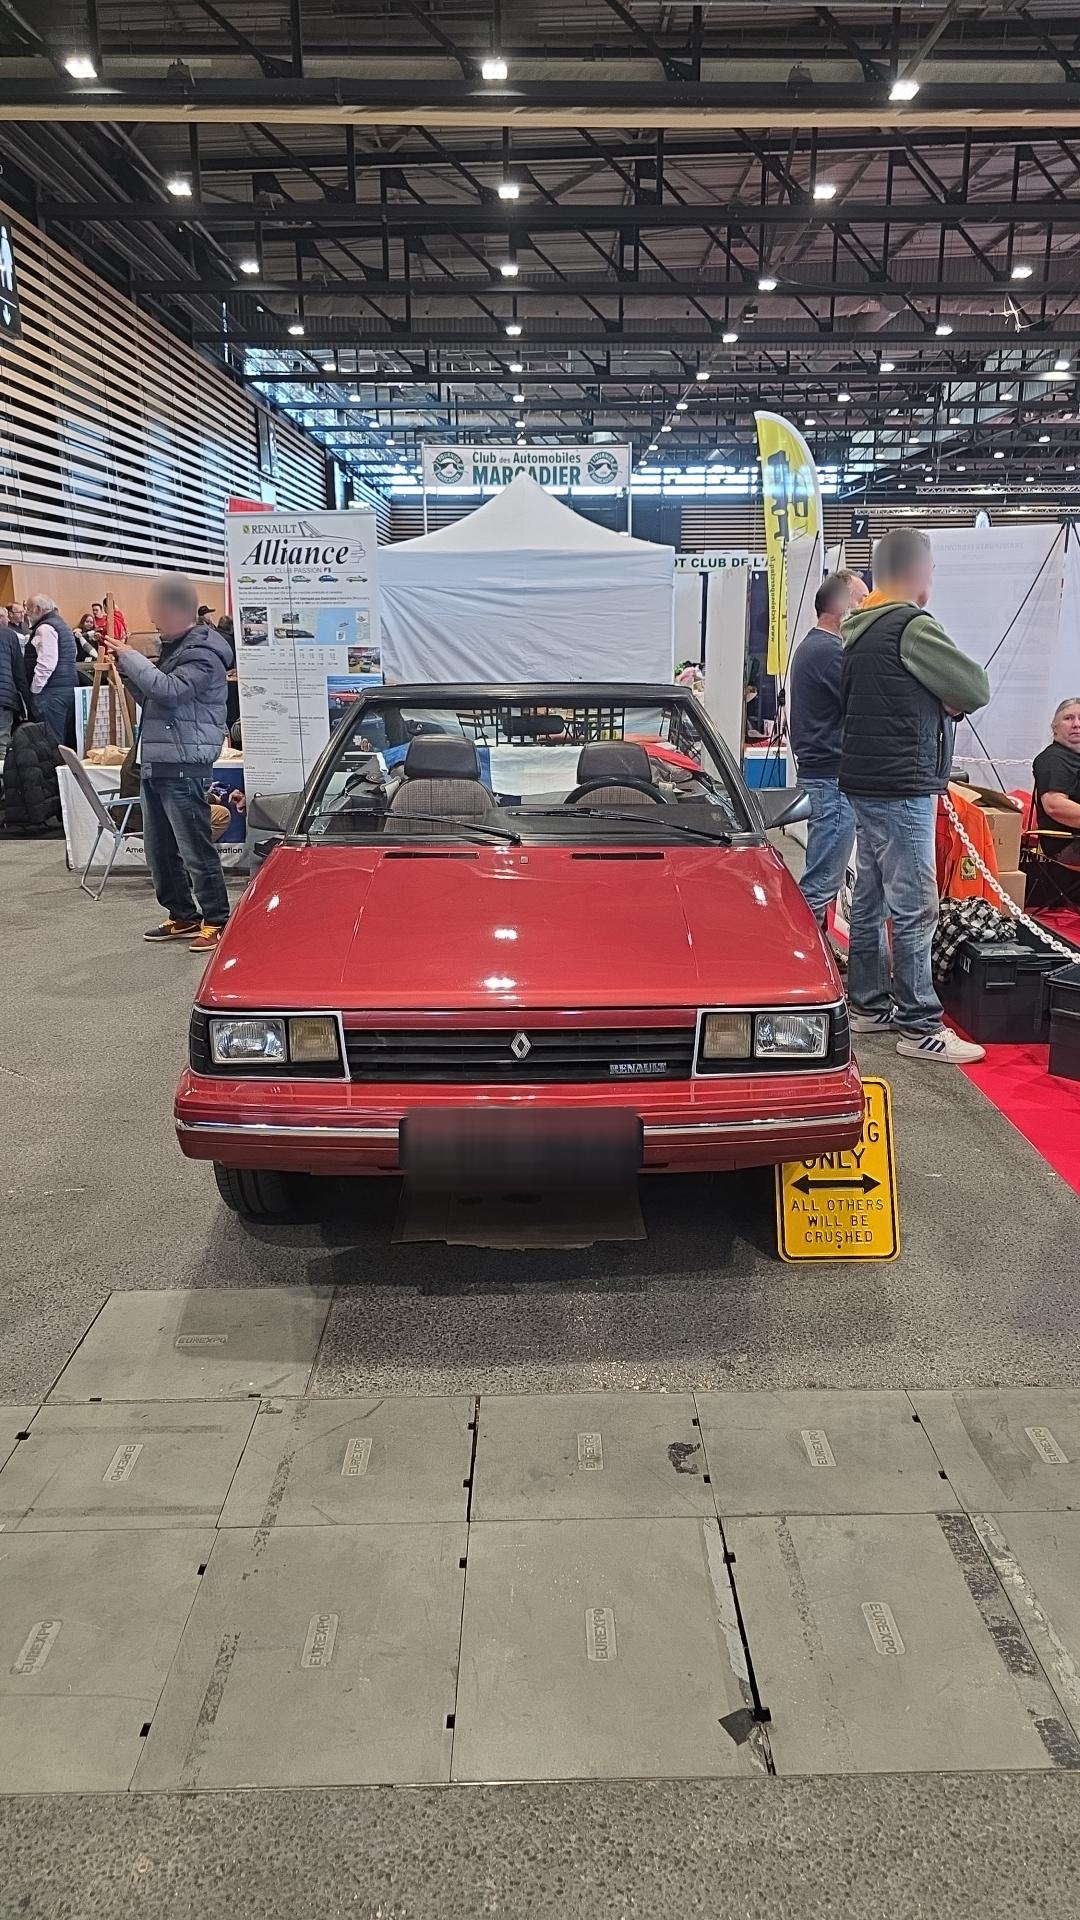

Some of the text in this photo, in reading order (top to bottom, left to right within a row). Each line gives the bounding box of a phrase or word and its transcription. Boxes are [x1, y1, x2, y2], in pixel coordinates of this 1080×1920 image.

[472, 451, 582, 464] Club des Automobiles
[251, 524, 297, 534] RENAULT
[855, 520, 865, 534] 7
[241, 538, 349, 566] Alliance
[691, 557, 727, 568] CLUB
[609, 1062, 667, 1075] RENAULT
[791, 1198, 884, 1212] ALL OTHERS
[808, 1214, 869, 1227] WILL BE
[804, 1230, 873, 1243] CRUSHED
[177, 1336, 226, 1345] EUREXPO
[348, 1439, 365, 1473] EUREXPO
[808, 1430, 828, 1465] EUREXPO
[1031, 1428, 1061, 1463] EUREXPO
[110, 1445, 137, 1481] EUREXPO
[592, 1608, 609, 1659] EUREXPO
[869, 1603, 899, 1654] EUREXPO
[18, 1621, 54, 1674] EUREXPO
[308, 1614, 331, 1666] EUREXPO
